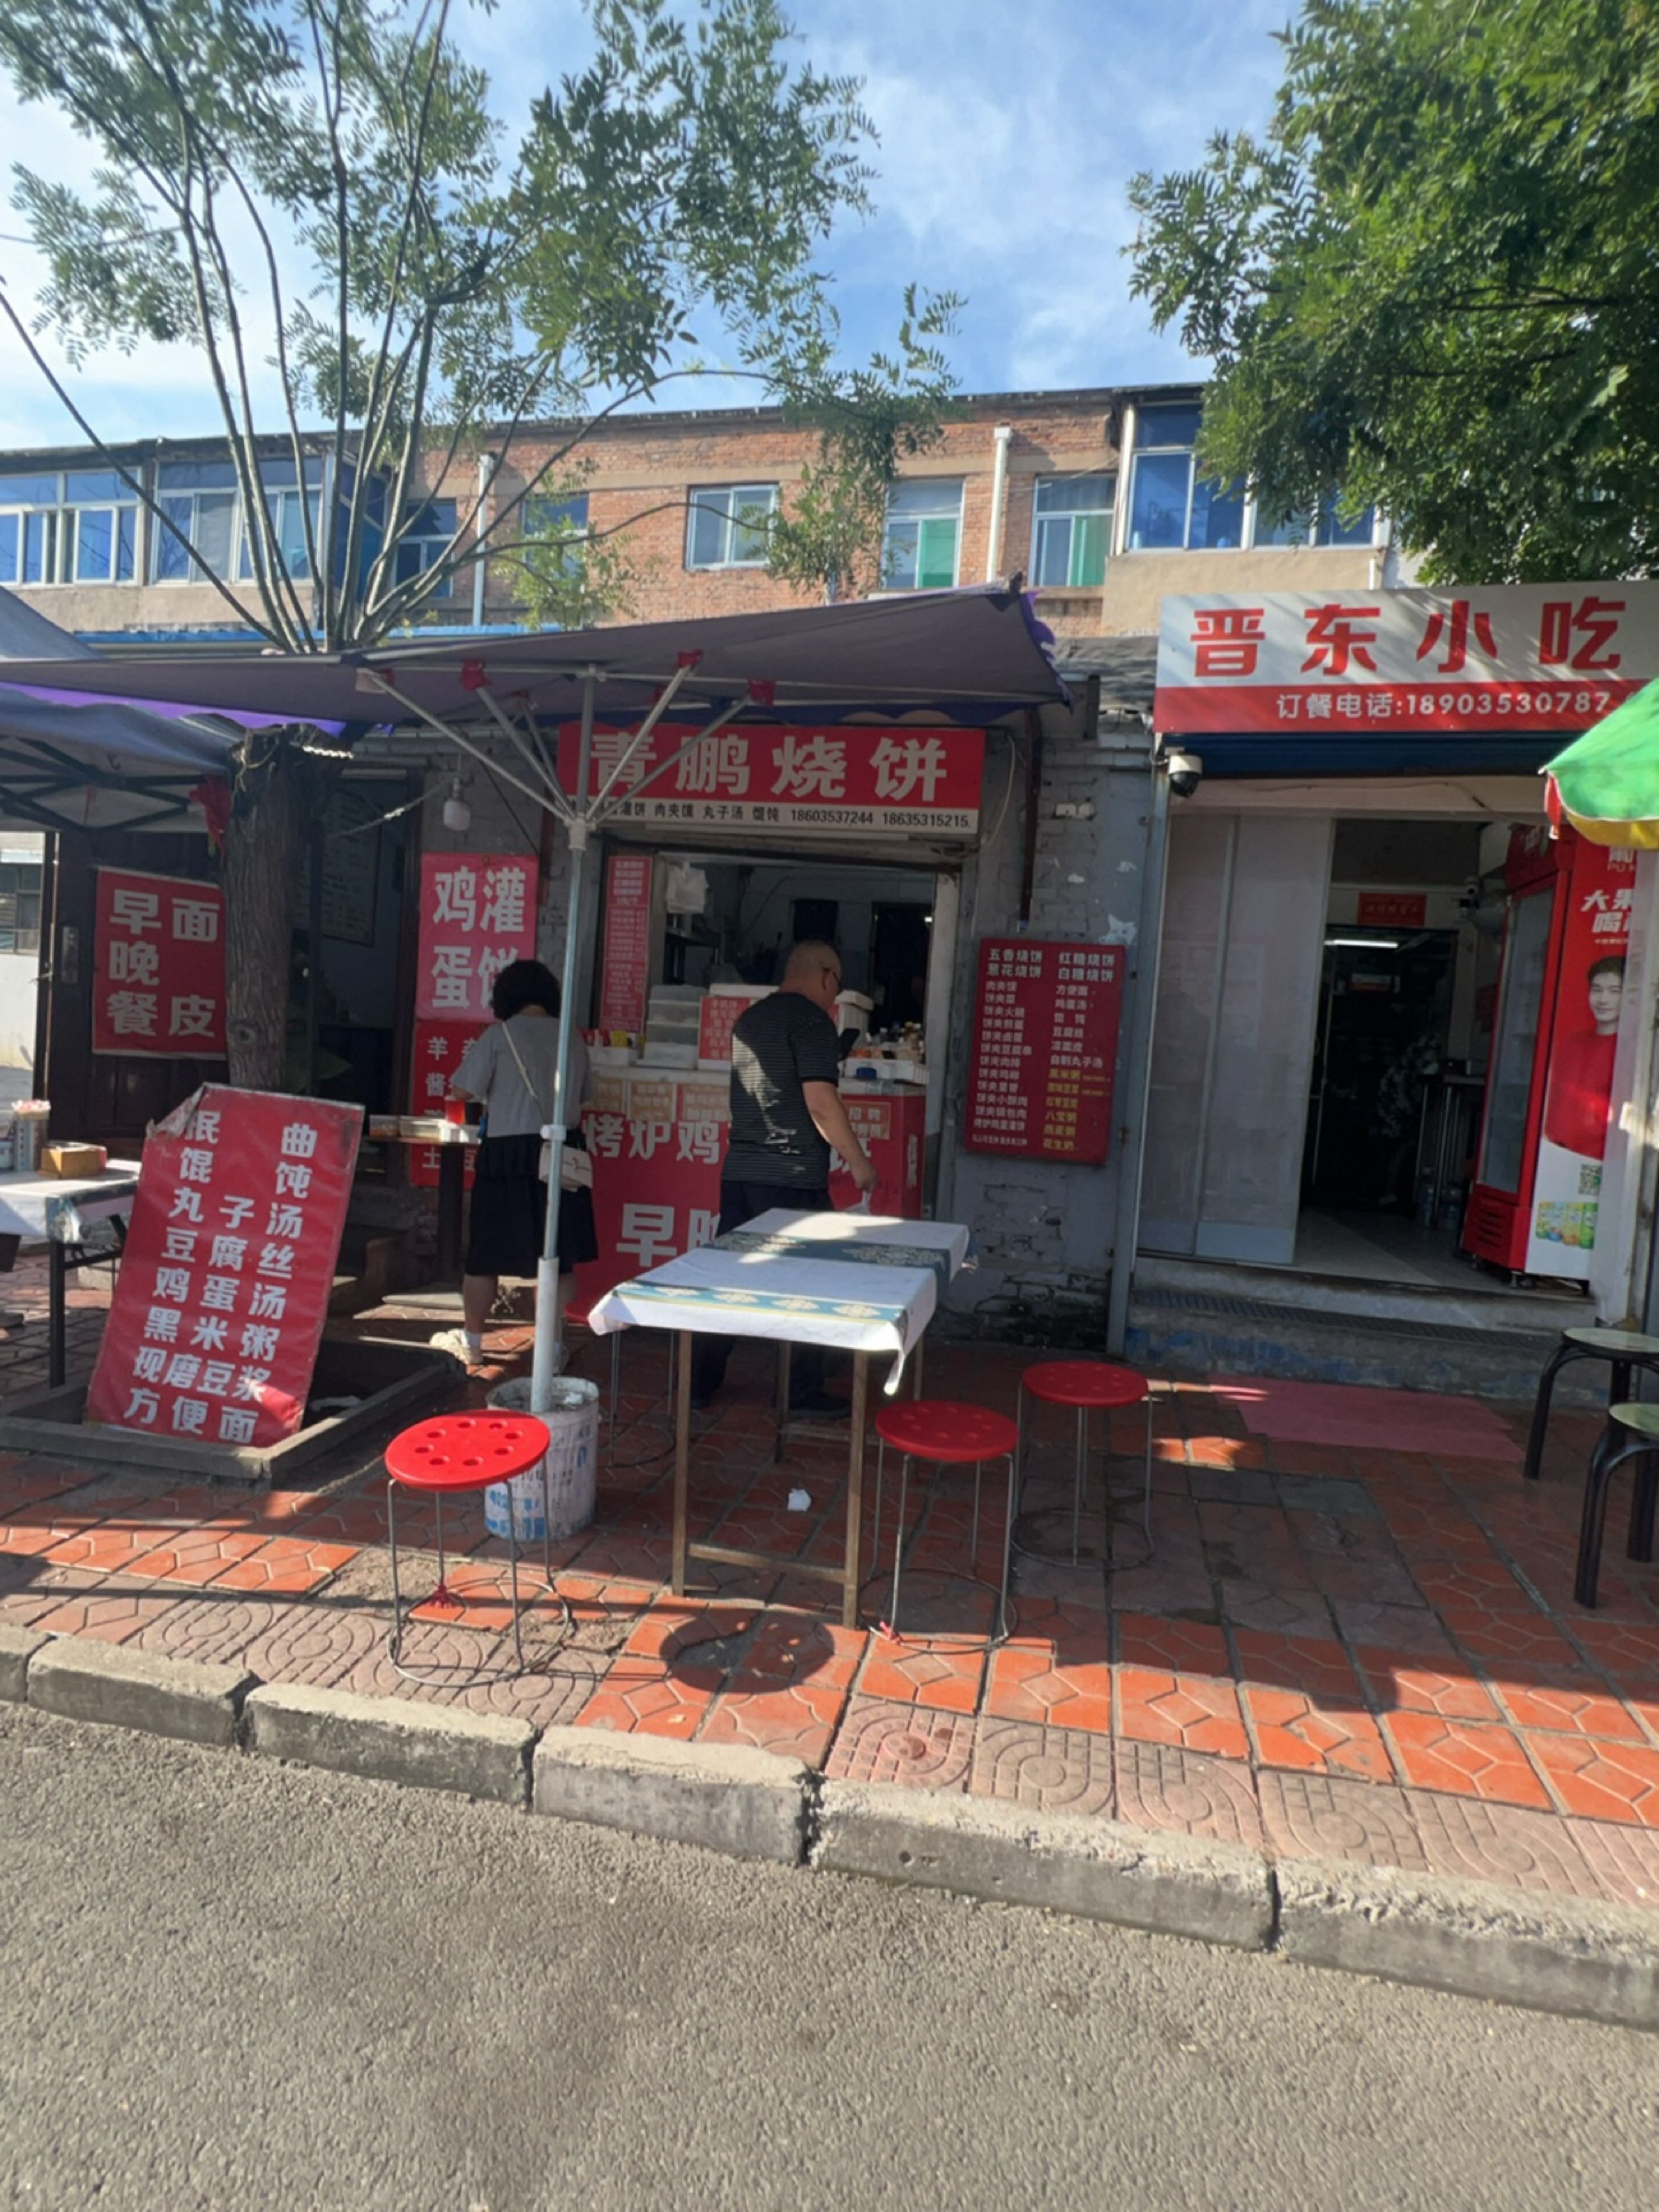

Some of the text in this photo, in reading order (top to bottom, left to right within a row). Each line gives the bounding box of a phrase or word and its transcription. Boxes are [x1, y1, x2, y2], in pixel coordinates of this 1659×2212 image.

[1190, 596, 1626, 677] 晋东小吃
[591, 732, 947, 802] 青鹏烧饼
[654, 802, 694, 819] 肉夹馍
[703, 804, 743, 821] 丸子汤
[752, 805, 779, 822] 馄饨
[790, 809, 874, 826] 18603537244
[883, 812, 968, 828] 18635315215
[106, 888, 163, 1037] 早晚餐
[168, 897, 221, 1038] 面皮
[582, 1113, 730, 1165] 烤炉鸡
[179, 1146, 312, 1199] 馄饨
[168, 1187, 303, 1240] 丸子汤
[161, 1226, 297, 1279] 豆腐丝
[152, 1266, 287, 1320] 鸡蛋汤
[143, 1305, 280, 1362] 黑米粥
[131, 1345, 271, 1402] 现磨豆浆
[124, 1388, 259, 1444] 方便面
